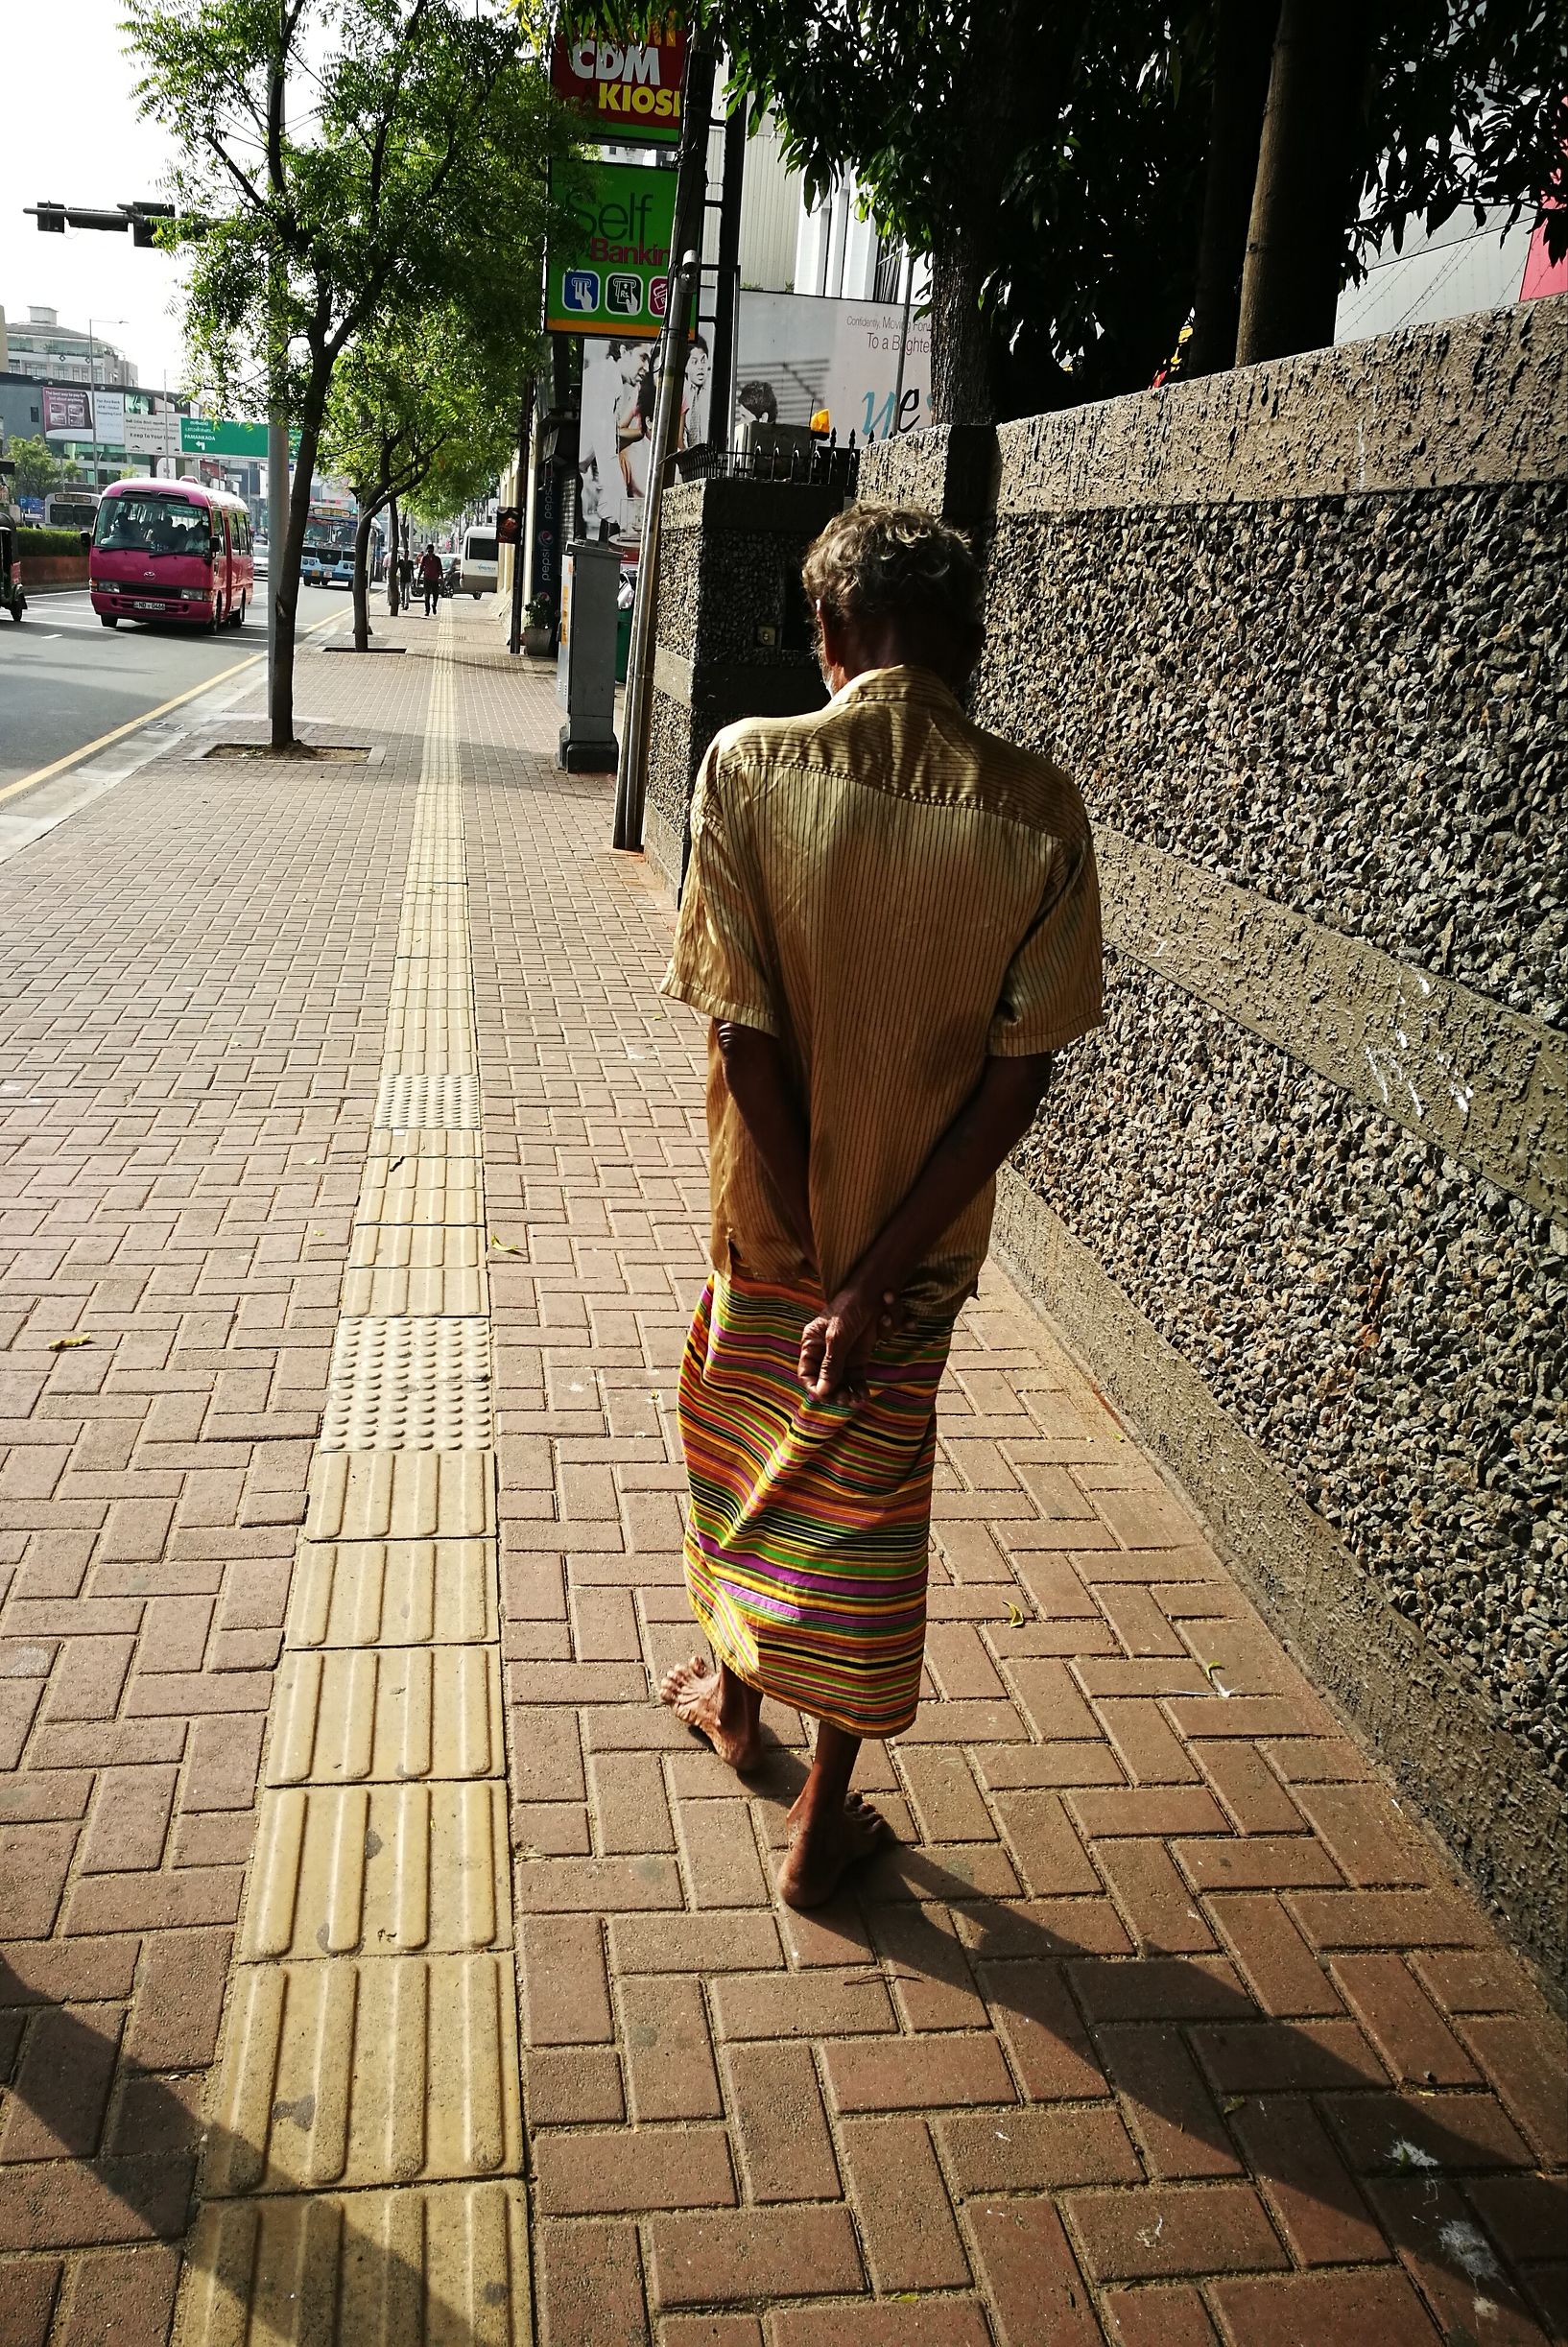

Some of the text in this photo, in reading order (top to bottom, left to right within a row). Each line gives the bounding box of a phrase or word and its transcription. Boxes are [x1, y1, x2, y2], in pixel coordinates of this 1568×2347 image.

[571, 39, 661, 85] CDM
[590, 237, 670, 266] Bankin
[882, 316, 912, 333] Movig
[867, 332, 932, 356] To a Bghte
[541, 548, 552, 581] pepsi
